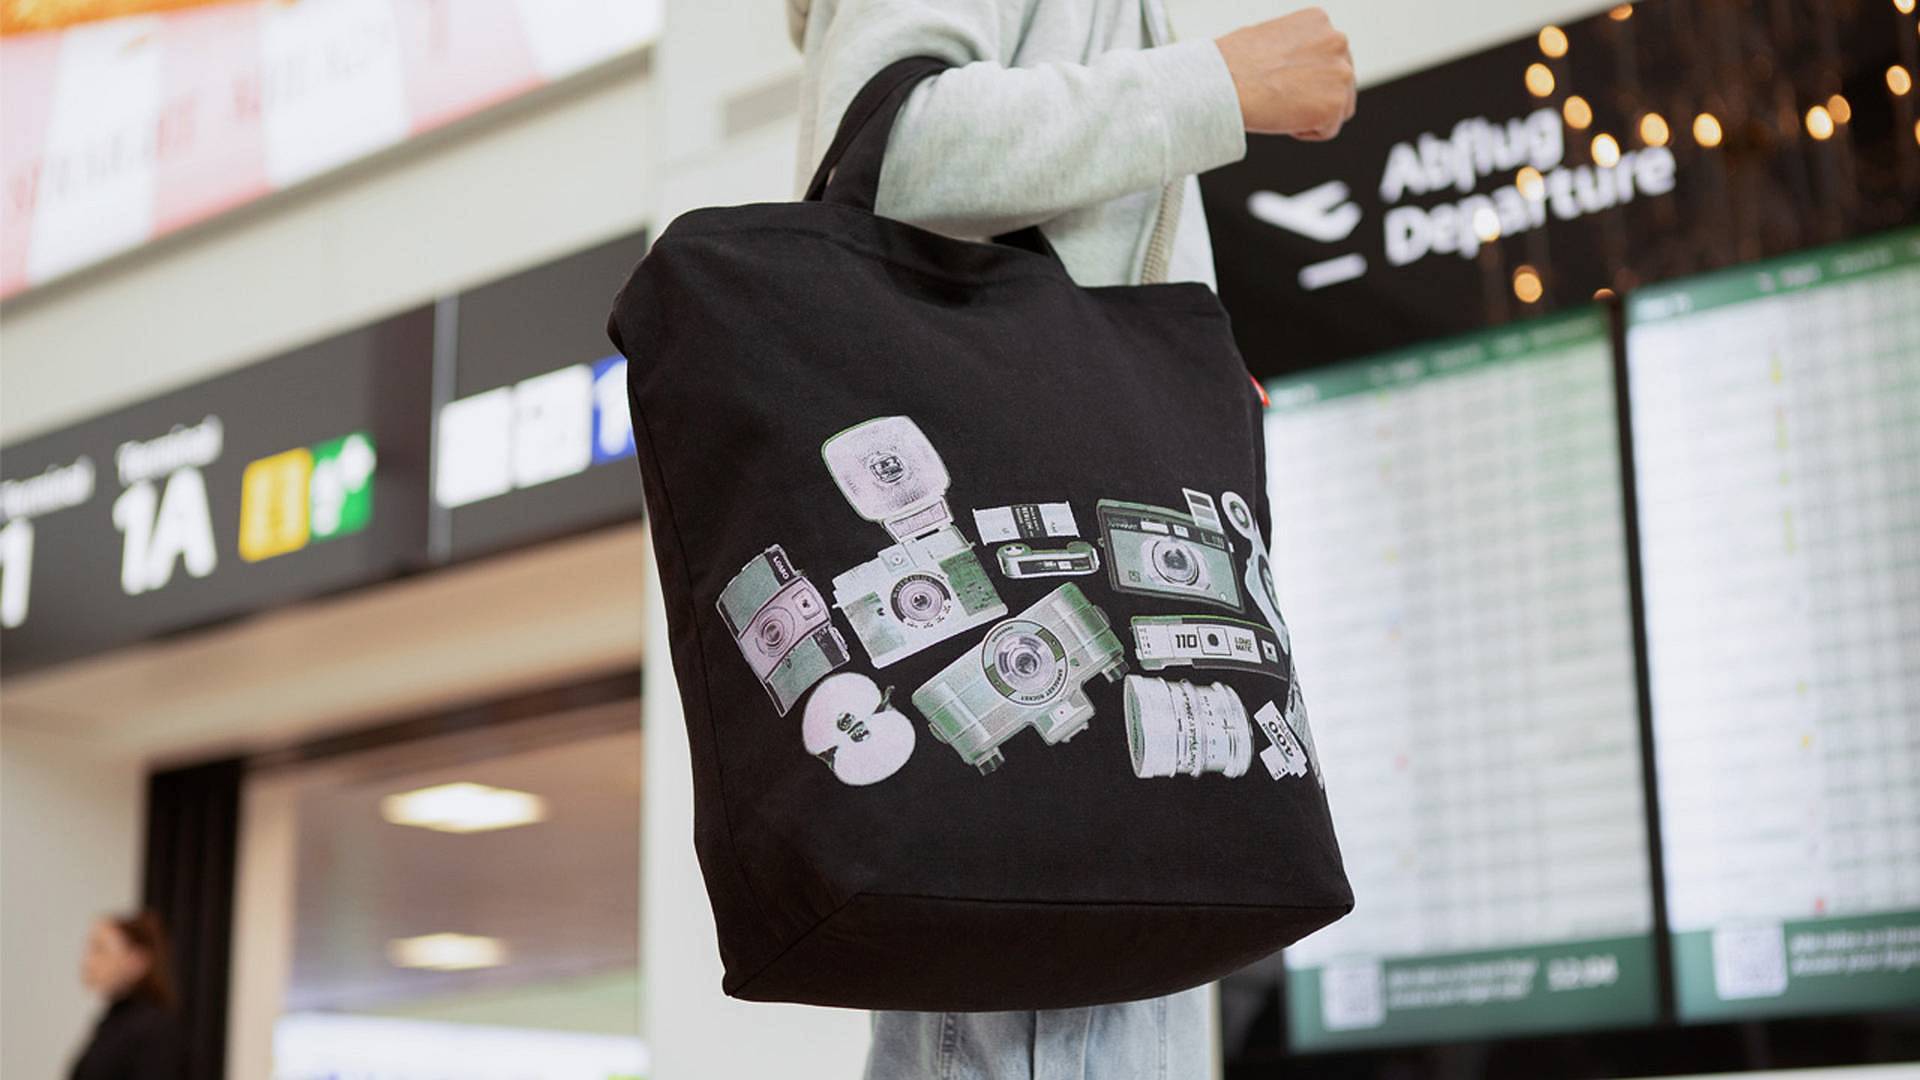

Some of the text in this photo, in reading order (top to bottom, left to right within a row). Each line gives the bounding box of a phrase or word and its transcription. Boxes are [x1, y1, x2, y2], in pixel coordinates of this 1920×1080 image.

[1380, 107, 1565, 203] Abflug
[1384, 146, 1677, 267] Departure
[114, 414, 224, 488] Terminal
[112, 465, 218, 596] 1A
[773, 555, 790, 580] LOMO
[1175, 633, 1198, 649] 110
[1268, 720, 1294, 758] 400
